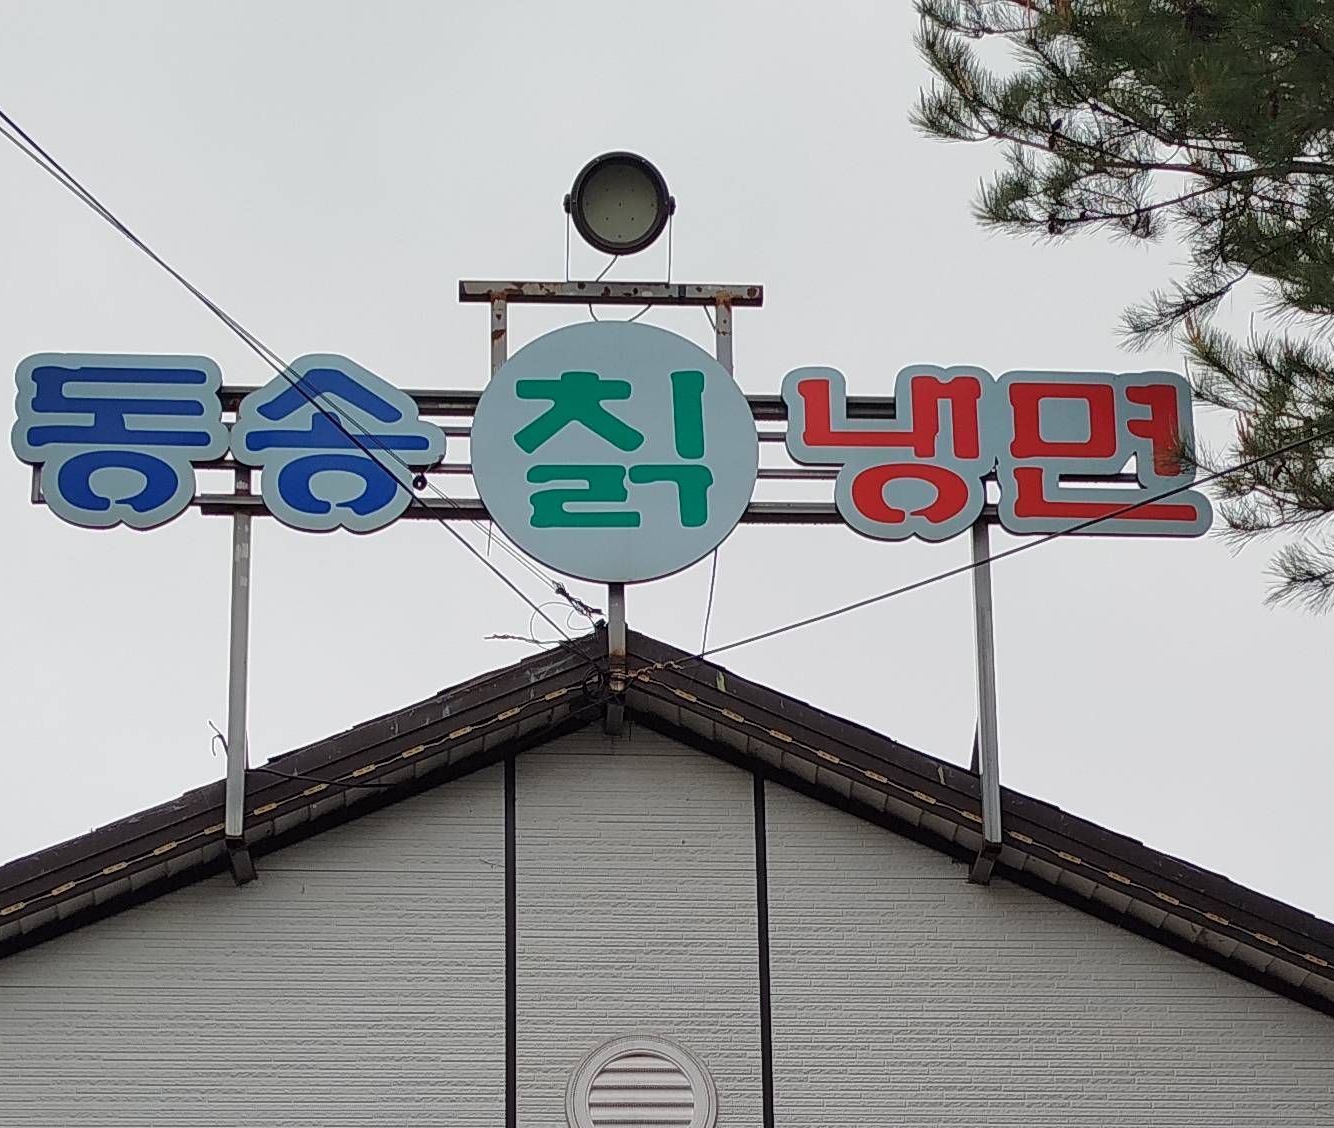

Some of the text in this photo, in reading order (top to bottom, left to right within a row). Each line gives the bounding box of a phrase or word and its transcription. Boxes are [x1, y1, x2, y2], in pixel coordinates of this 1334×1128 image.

[27, 365, 1199, 530] 동송 칡 냉면
